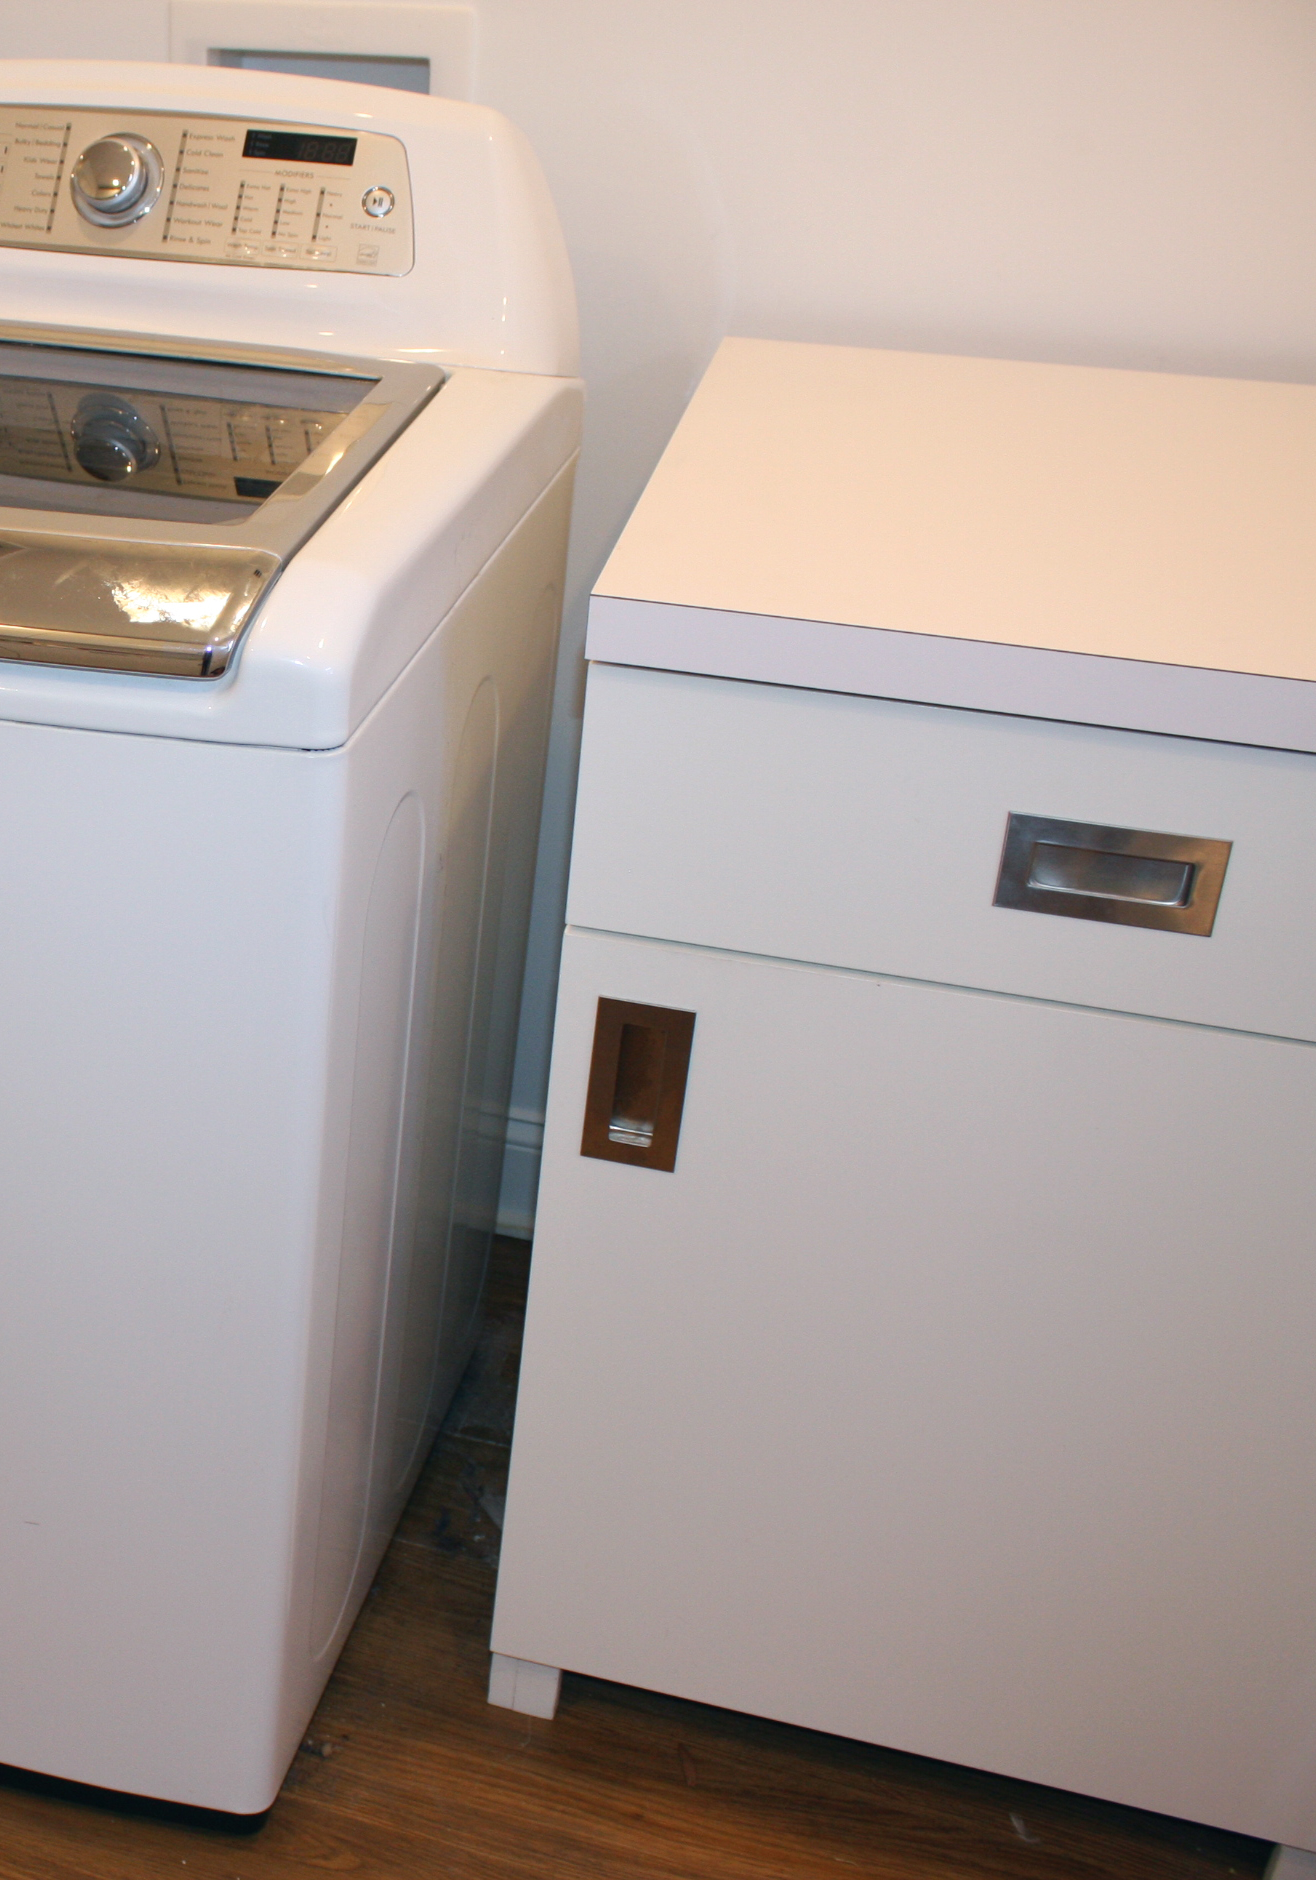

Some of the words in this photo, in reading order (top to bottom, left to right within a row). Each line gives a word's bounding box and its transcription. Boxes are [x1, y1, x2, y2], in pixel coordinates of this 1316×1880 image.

[189, 133, 214, 141] Express
[183, 167, 209, 175] Sanitize
[274, 170, 315, 179] MODIFIERS
[179, 184, 210, 192] Delicates
[176, 200, 208, 208] Handwash
[34, 206, 48, 214] Duty
[173, 217, 202, 226] Workout
[204, 219, 223, 227] Wear
[169, 234, 186, 242] Rinse
[196, 237, 211, 245] Spin
